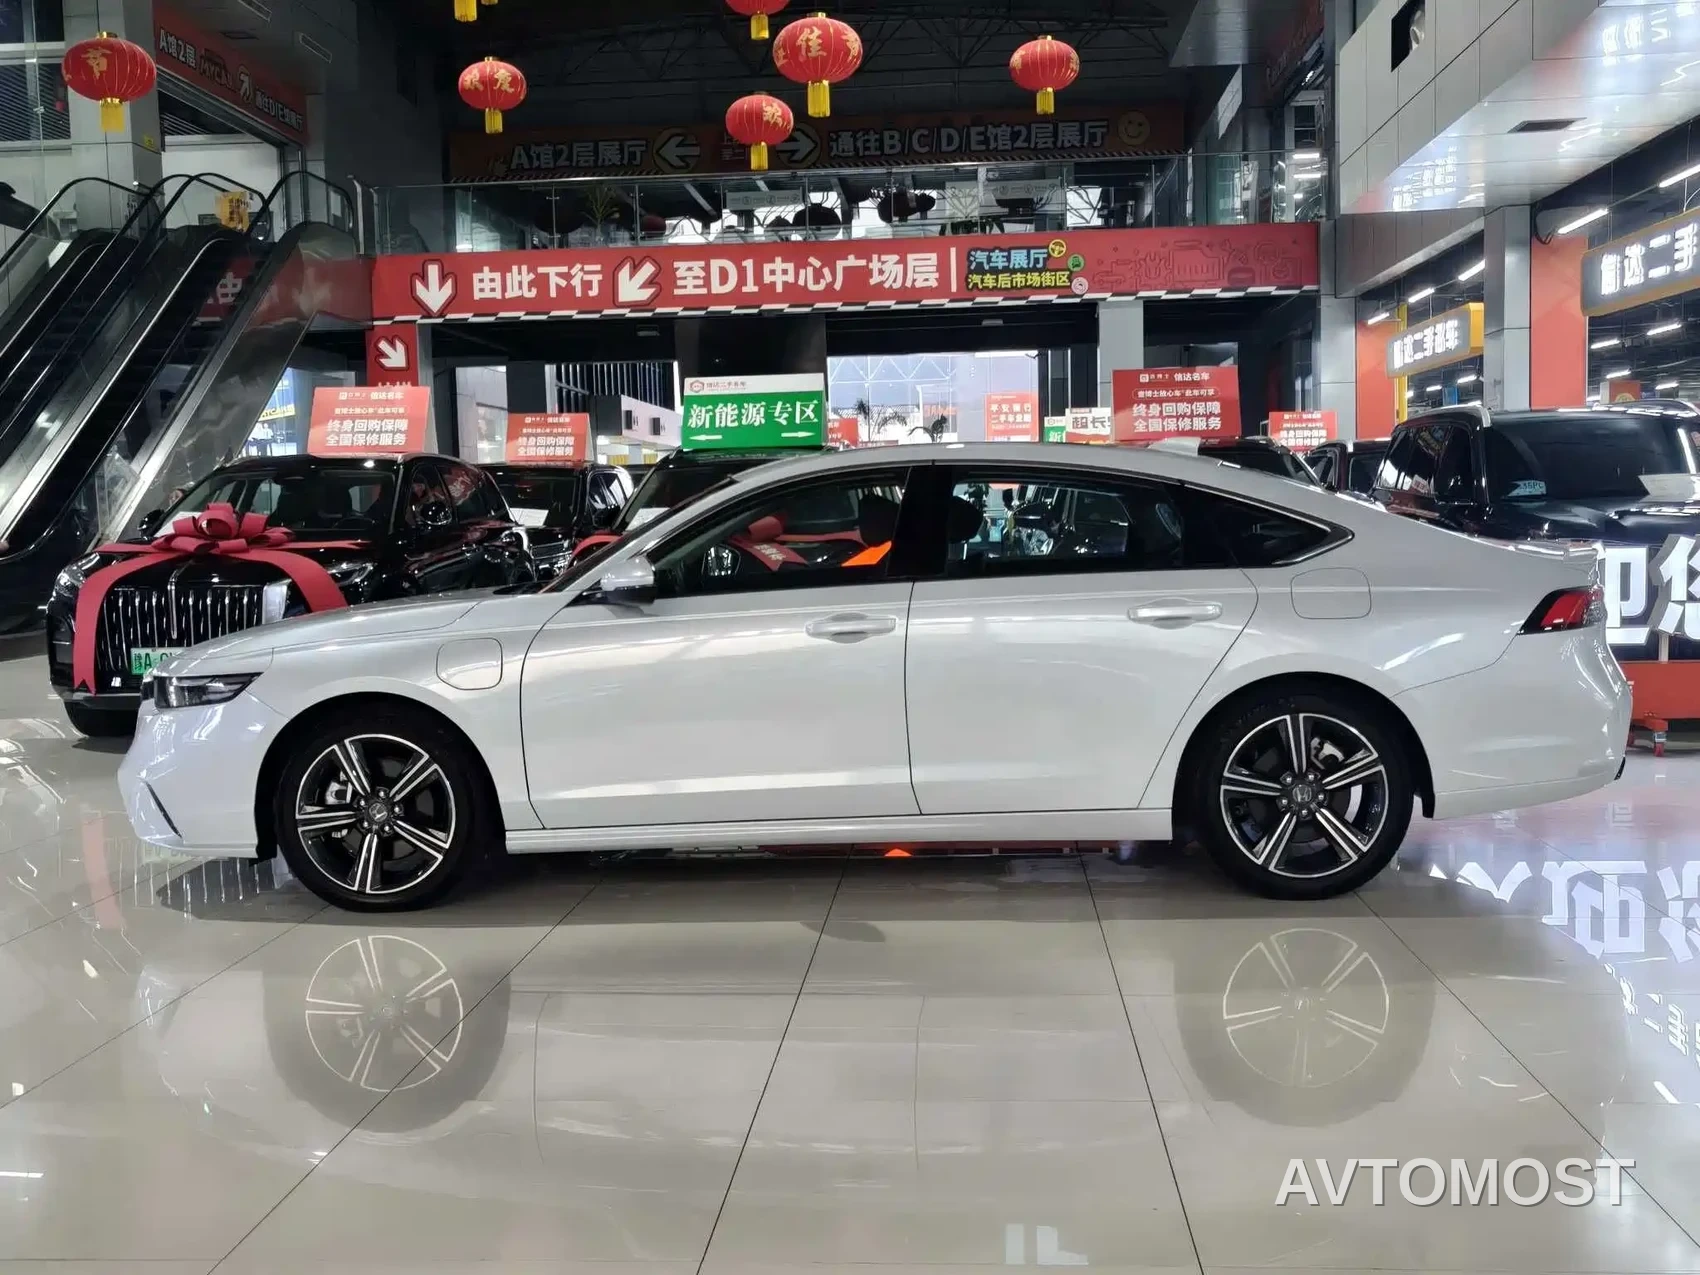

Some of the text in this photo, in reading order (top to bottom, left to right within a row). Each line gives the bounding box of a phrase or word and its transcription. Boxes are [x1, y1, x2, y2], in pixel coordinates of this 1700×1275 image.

[828, 120, 1109, 159] 通往B/C/D/E馆2层展厅
[510, 139, 648, 171] A馆2层展厅
[968, 248, 1048, 271] 汽车展厅
[472, 262, 603, 301] 由此下行
[672, 252, 940, 296] 至D1中心广场层
[967, 271, 1071, 290] 汽车后市场街区
[686, 400, 819, 429] 新能源专区
[1132, 400, 1222, 417] 终身回购保障
[326, 418, 409, 432] 终身回购保障
[1072, 415, 1111, 429] 超长
[1133, 416, 1222, 433] 全国保修服务
[325, 432, 407, 447] 全国保修服务
